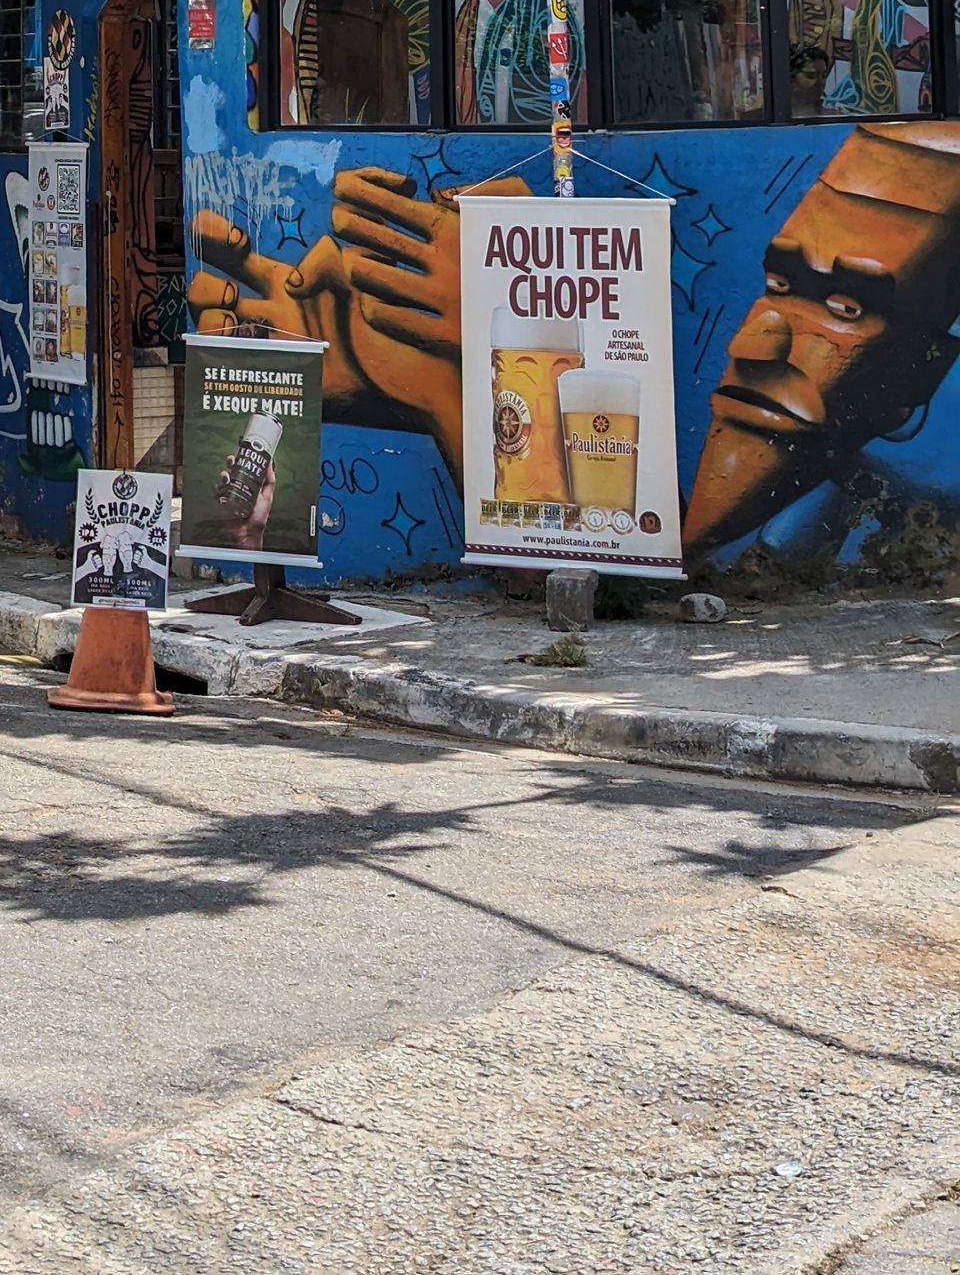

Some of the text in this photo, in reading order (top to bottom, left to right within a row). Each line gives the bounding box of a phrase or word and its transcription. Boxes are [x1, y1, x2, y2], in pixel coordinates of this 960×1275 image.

[484, 225, 643, 274] AQUI TEM
[509, 274, 620, 321] CHOPE
[618, 329, 640, 339] CHOPE
[607, 340, 645, 351] ARTESANAL
[604, 351, 614, 360] DE
[627, 352, 649, 362] PAULO
[204, 365, 304, 385] SE É REFRESCANTE
[204, 382, 213, 390] SE
[214, 382, 229, 392] TEM
[229, 383, 252, 393] GOSTO
[264, 386, 303, 397] LIBERDADE
[202, 390, 304, 417] É XEQUE MATE!
[572, 433, 632, 455] Paulistânia
[237, 457, 263, 477] MATE
[240, 447, 268, 469] XEQUE
[97, 501, 151, 521] CHOPP
[81, 528, 95, 537] IPA
[522, 534, 621, 550] www.paulistania.com.br
[88, 575, 114, 584] 300ML
